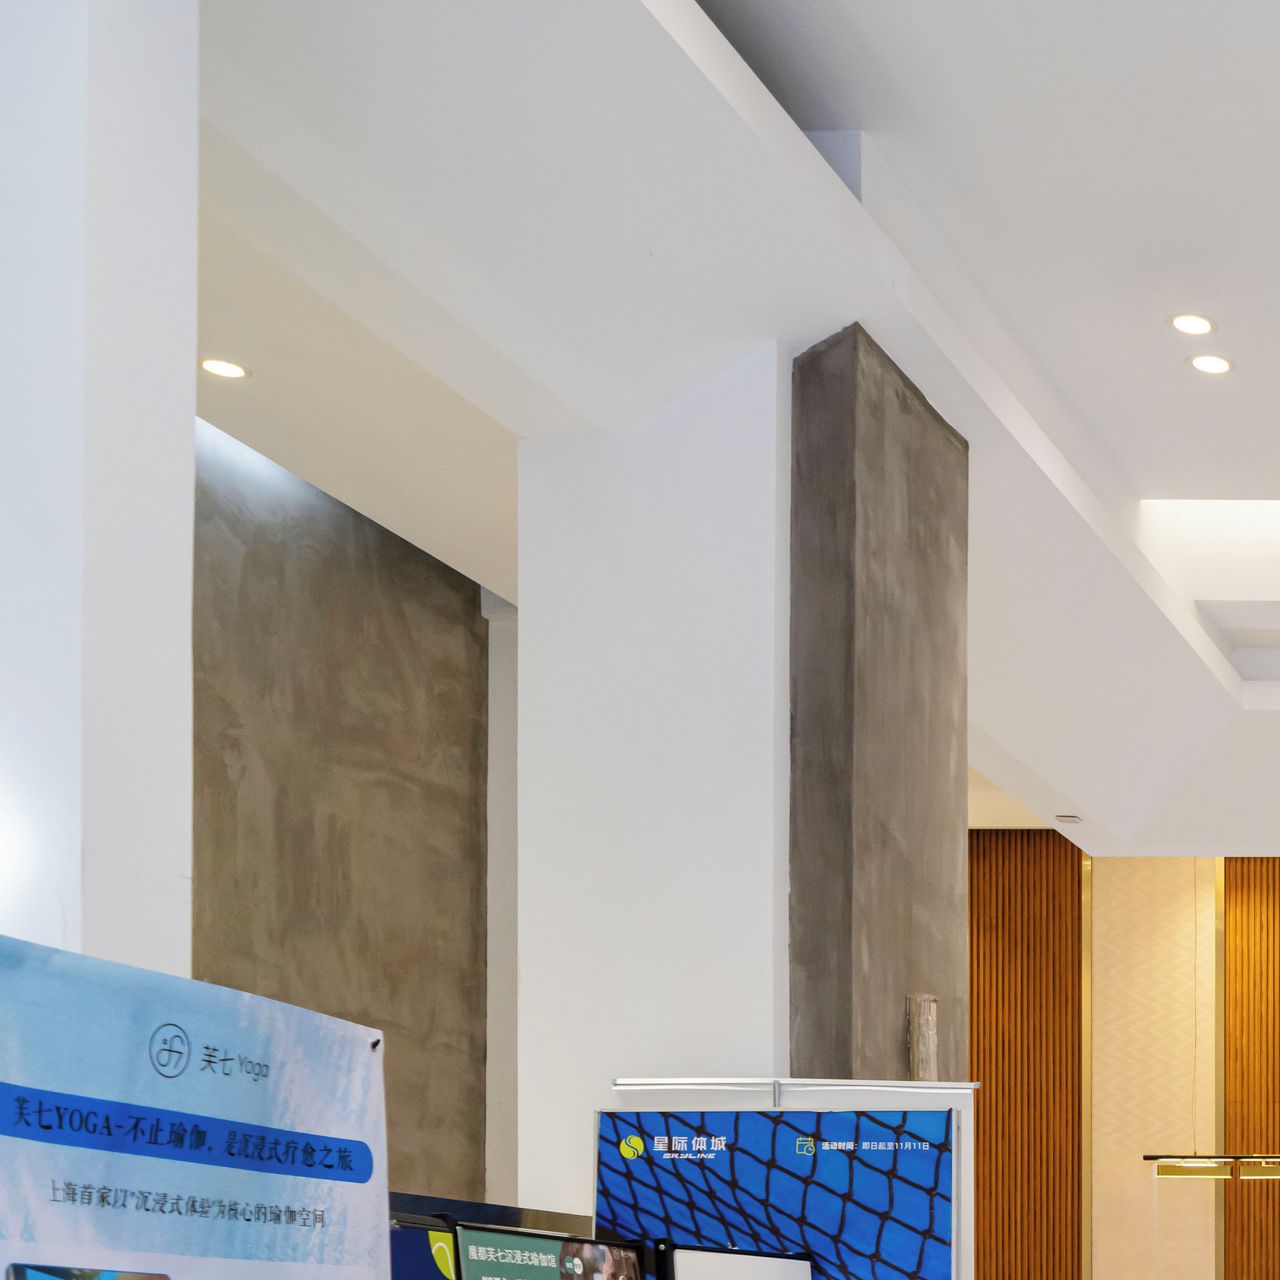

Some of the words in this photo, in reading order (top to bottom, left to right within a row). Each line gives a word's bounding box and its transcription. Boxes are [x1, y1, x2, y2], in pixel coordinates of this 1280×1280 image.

[238, 1054, 269, 1081] Yoga
[653, 1136, 727, 1152] 星际体城
[663, 1152, 717, 1160] SKYLINE
